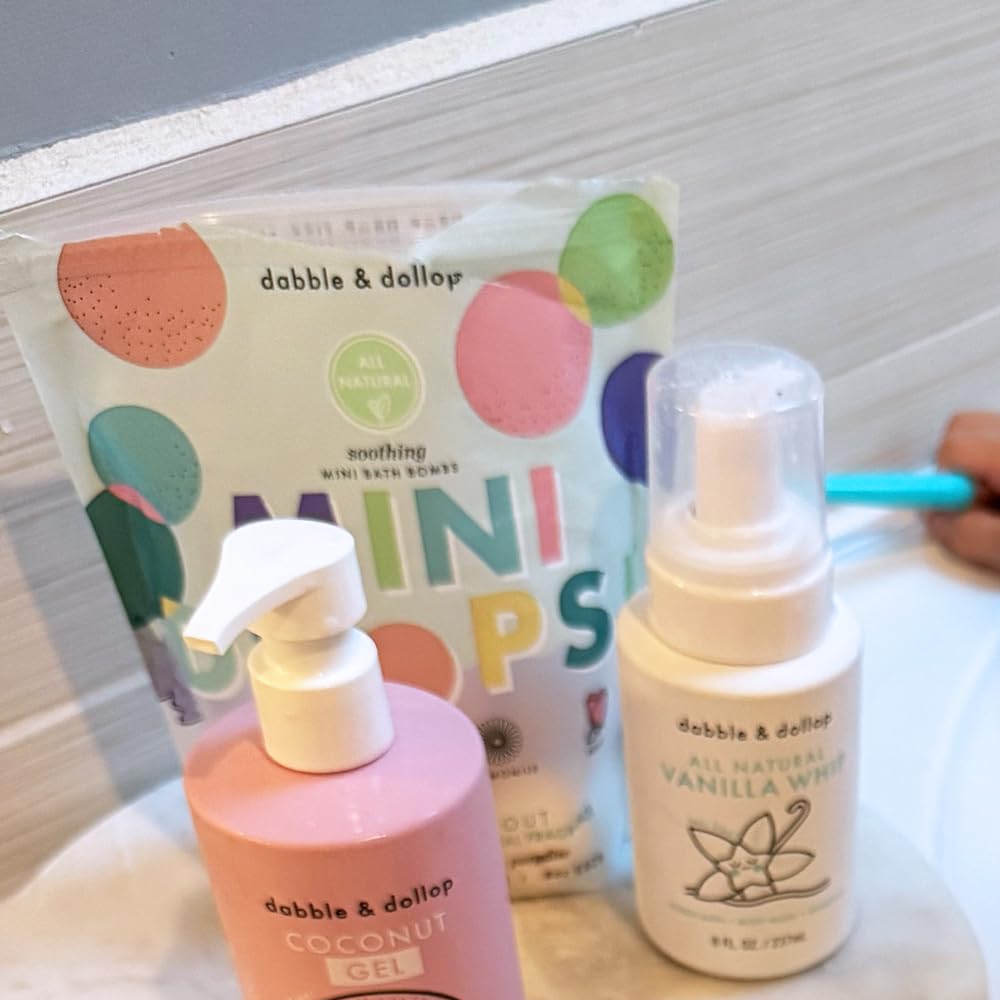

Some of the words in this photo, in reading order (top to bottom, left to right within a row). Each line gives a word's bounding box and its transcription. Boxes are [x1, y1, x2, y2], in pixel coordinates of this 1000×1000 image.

[260, 266, 345, 290] dabble
[354, 267, 372, 289] &
[380, 263, 464, 291] dollop
[337, 374, 411, 389] NATURAL
[347, 442, 426, 463] soothing
[320, 466, 359, 480] MINI
[362, 465, 401, 480] BATH
[406, 462, 460, 478] BOMBS
[677, 717, 748, 742] dabble
[756, 726, 769, 741] &
[776, 712, 832, 739] dollop
[690, 755, 722, 774] ALL
[734, 748, 825, 774] NATURAL
[660, 762, 780, 799] VANILLA
[264, 897, 348, 920] dabble
[358, 901, 376, 917] &
[384, 878, 454, 913] dollop
[285, 912, 447, 954] COCONUT
[347, 959, 405, 981] GEL
